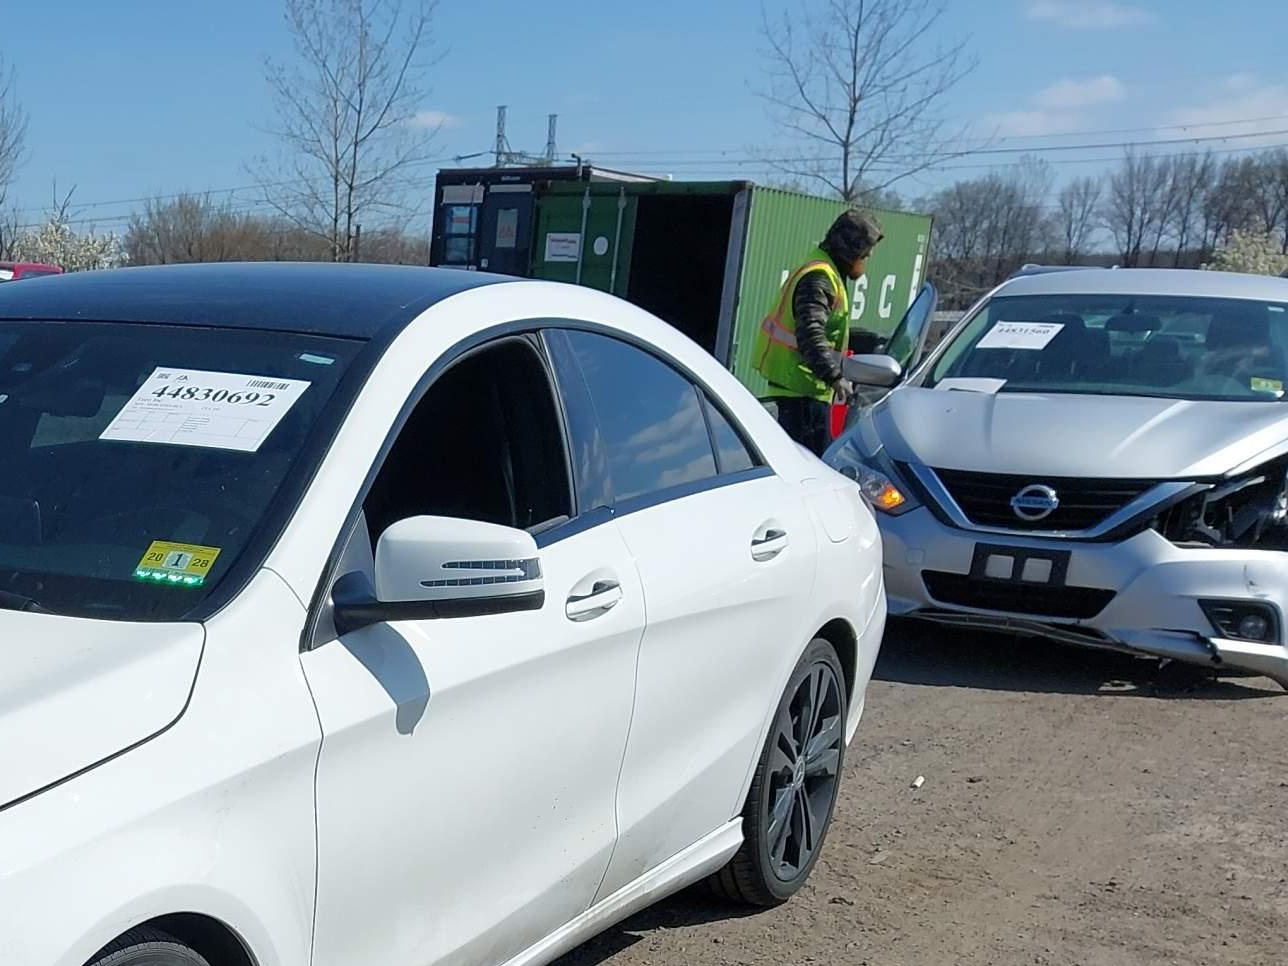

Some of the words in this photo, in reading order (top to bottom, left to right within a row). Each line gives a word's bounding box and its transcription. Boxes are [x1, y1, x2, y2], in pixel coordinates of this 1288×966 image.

[152, 384, 276, 407] 44830692
[147, 552, 164, 562] 20
[172, 553, 184, 567] 1
[192, 558, 210, 568] 28
